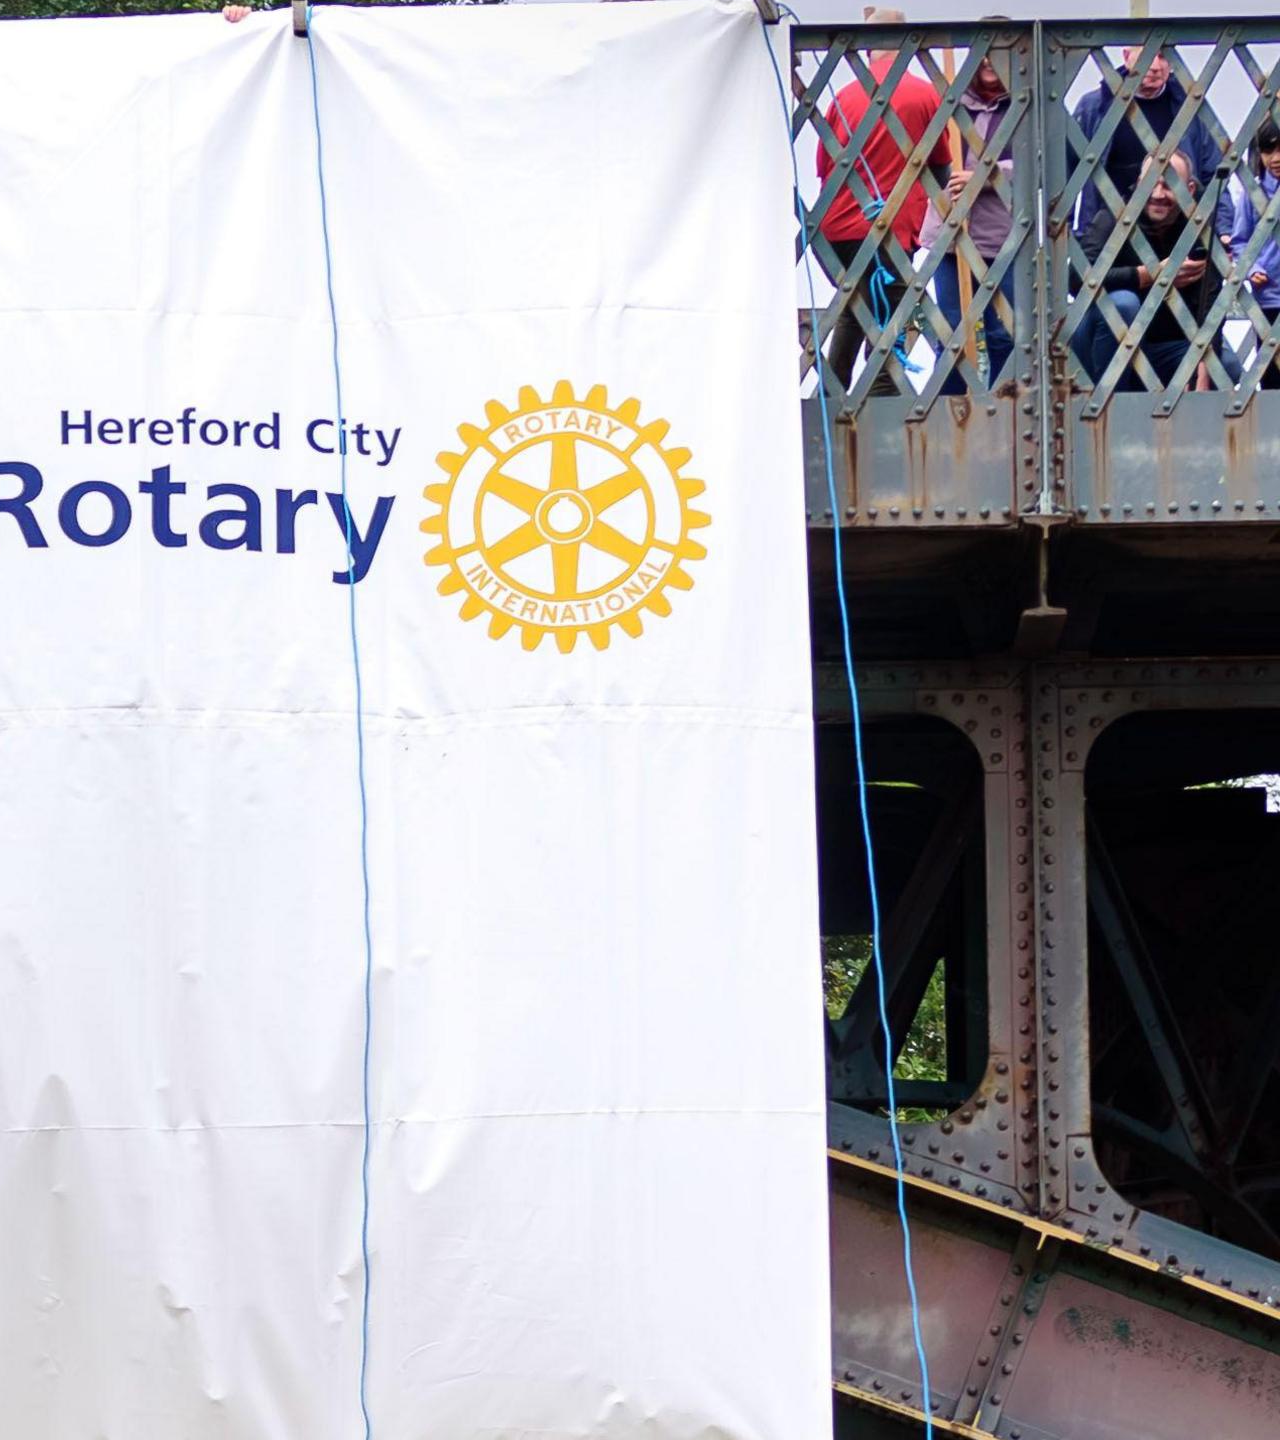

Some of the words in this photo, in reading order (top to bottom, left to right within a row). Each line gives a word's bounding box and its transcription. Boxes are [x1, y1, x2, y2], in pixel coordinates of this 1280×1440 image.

[60, 406, 281, 450] Hereford
[305, 418, 402, 466] City
[502, 409, 623, 446] ROTARY
[465, 560, 669, 625] INTERNATIONAL
